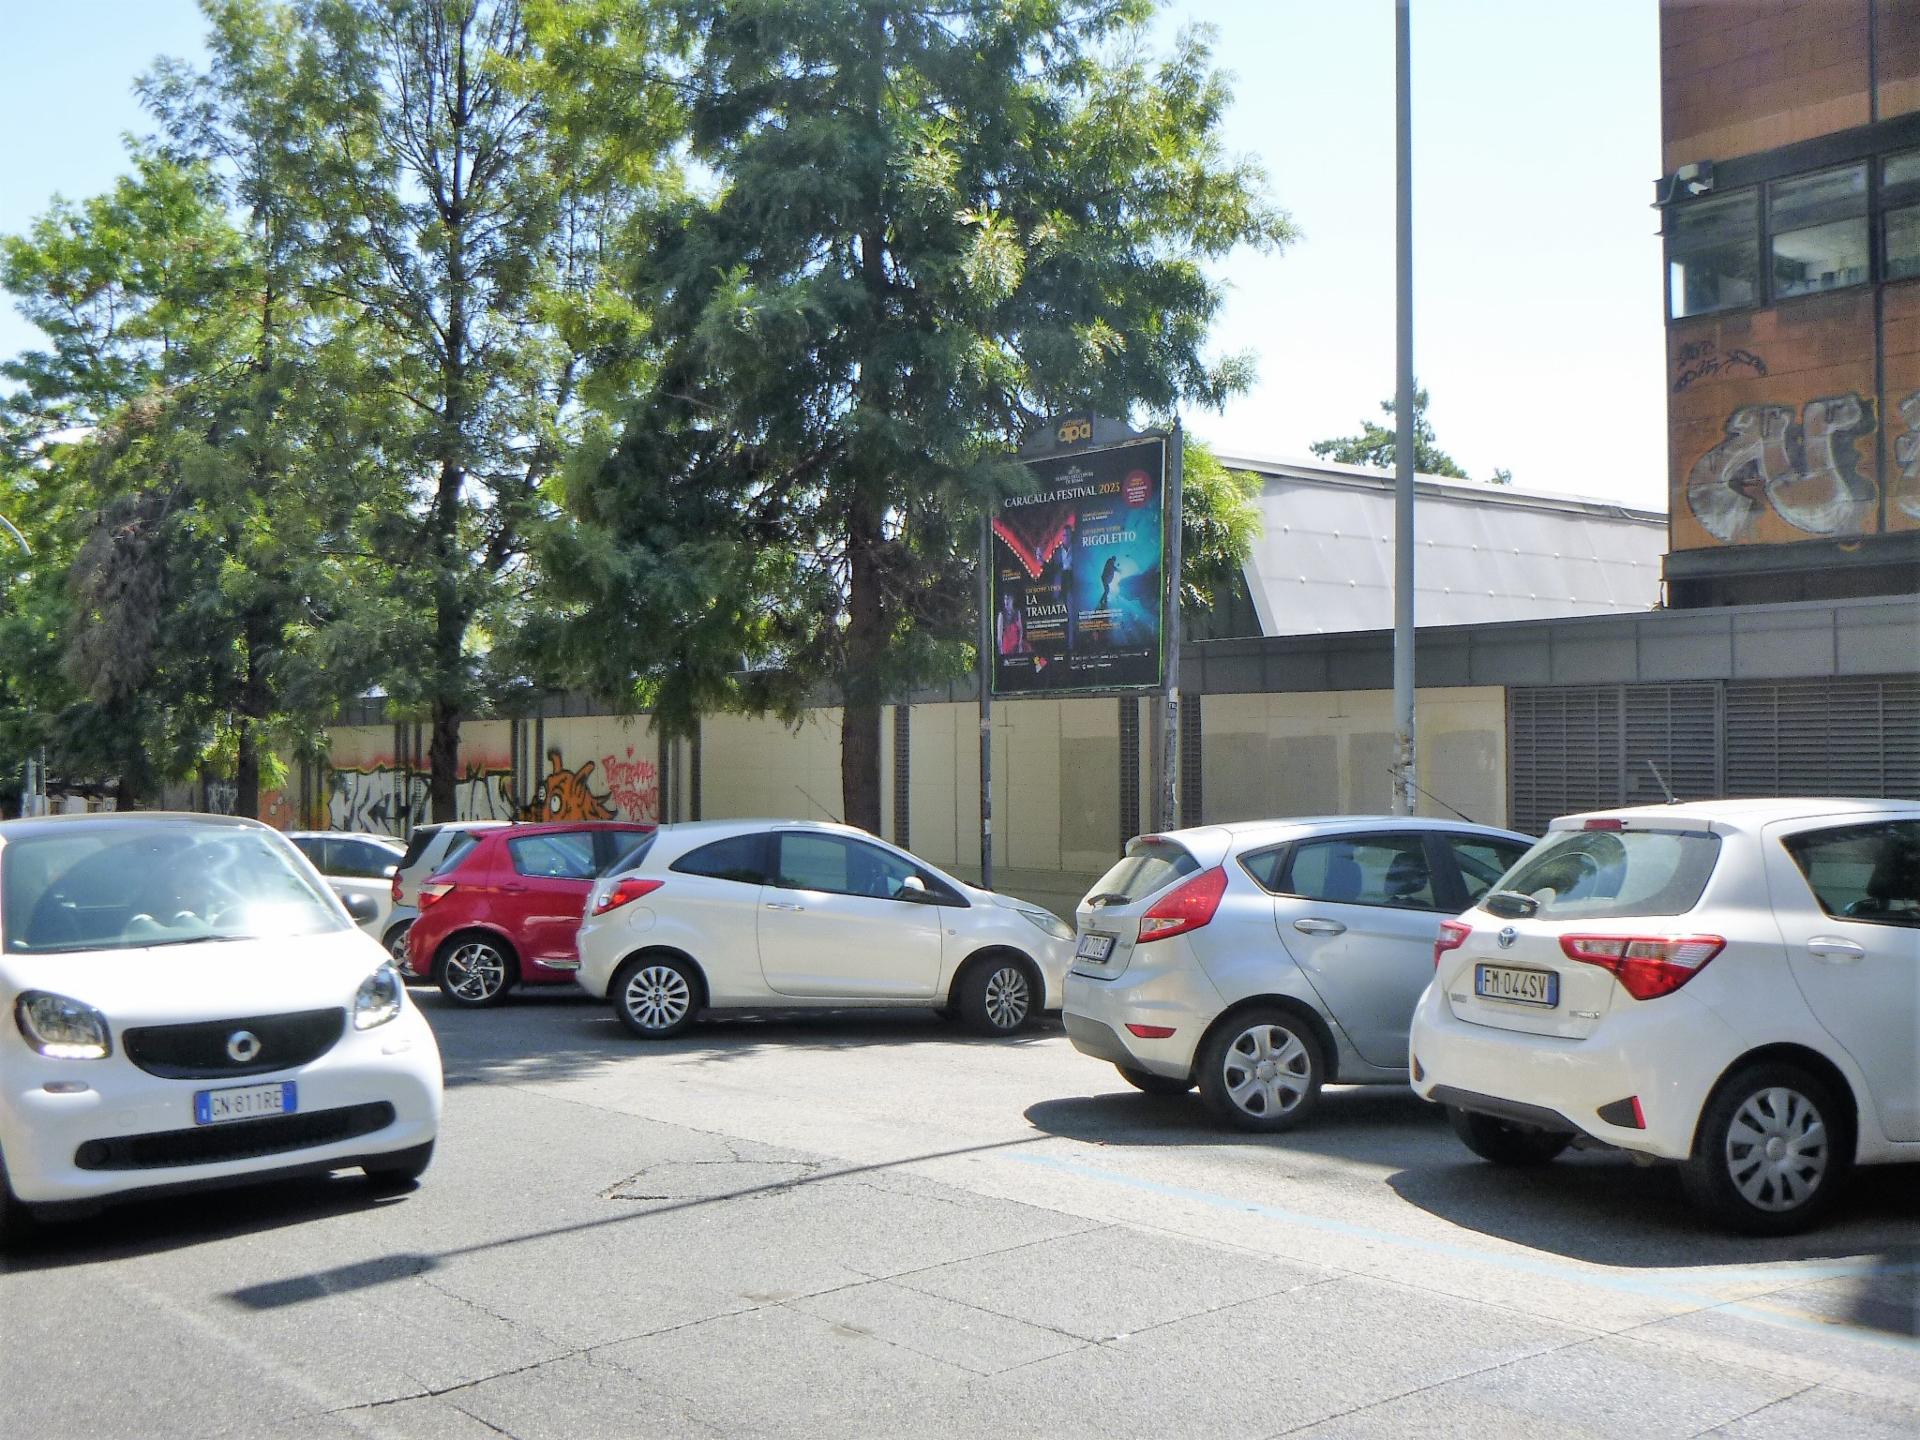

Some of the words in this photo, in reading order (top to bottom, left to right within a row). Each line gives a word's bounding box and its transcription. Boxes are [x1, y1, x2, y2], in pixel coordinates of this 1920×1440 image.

[1004, 491, 1055, 508] CARACALLA
[1057, 485, 1097, 500] FESTIVAL
[1099, 482, 1120, 494] 2023
[1082, 530, 1136, 547] RIGOLETTO
[1026, 594, 1038, 605] LA
[1026, 604, 1068, 617] TRAVIATA
